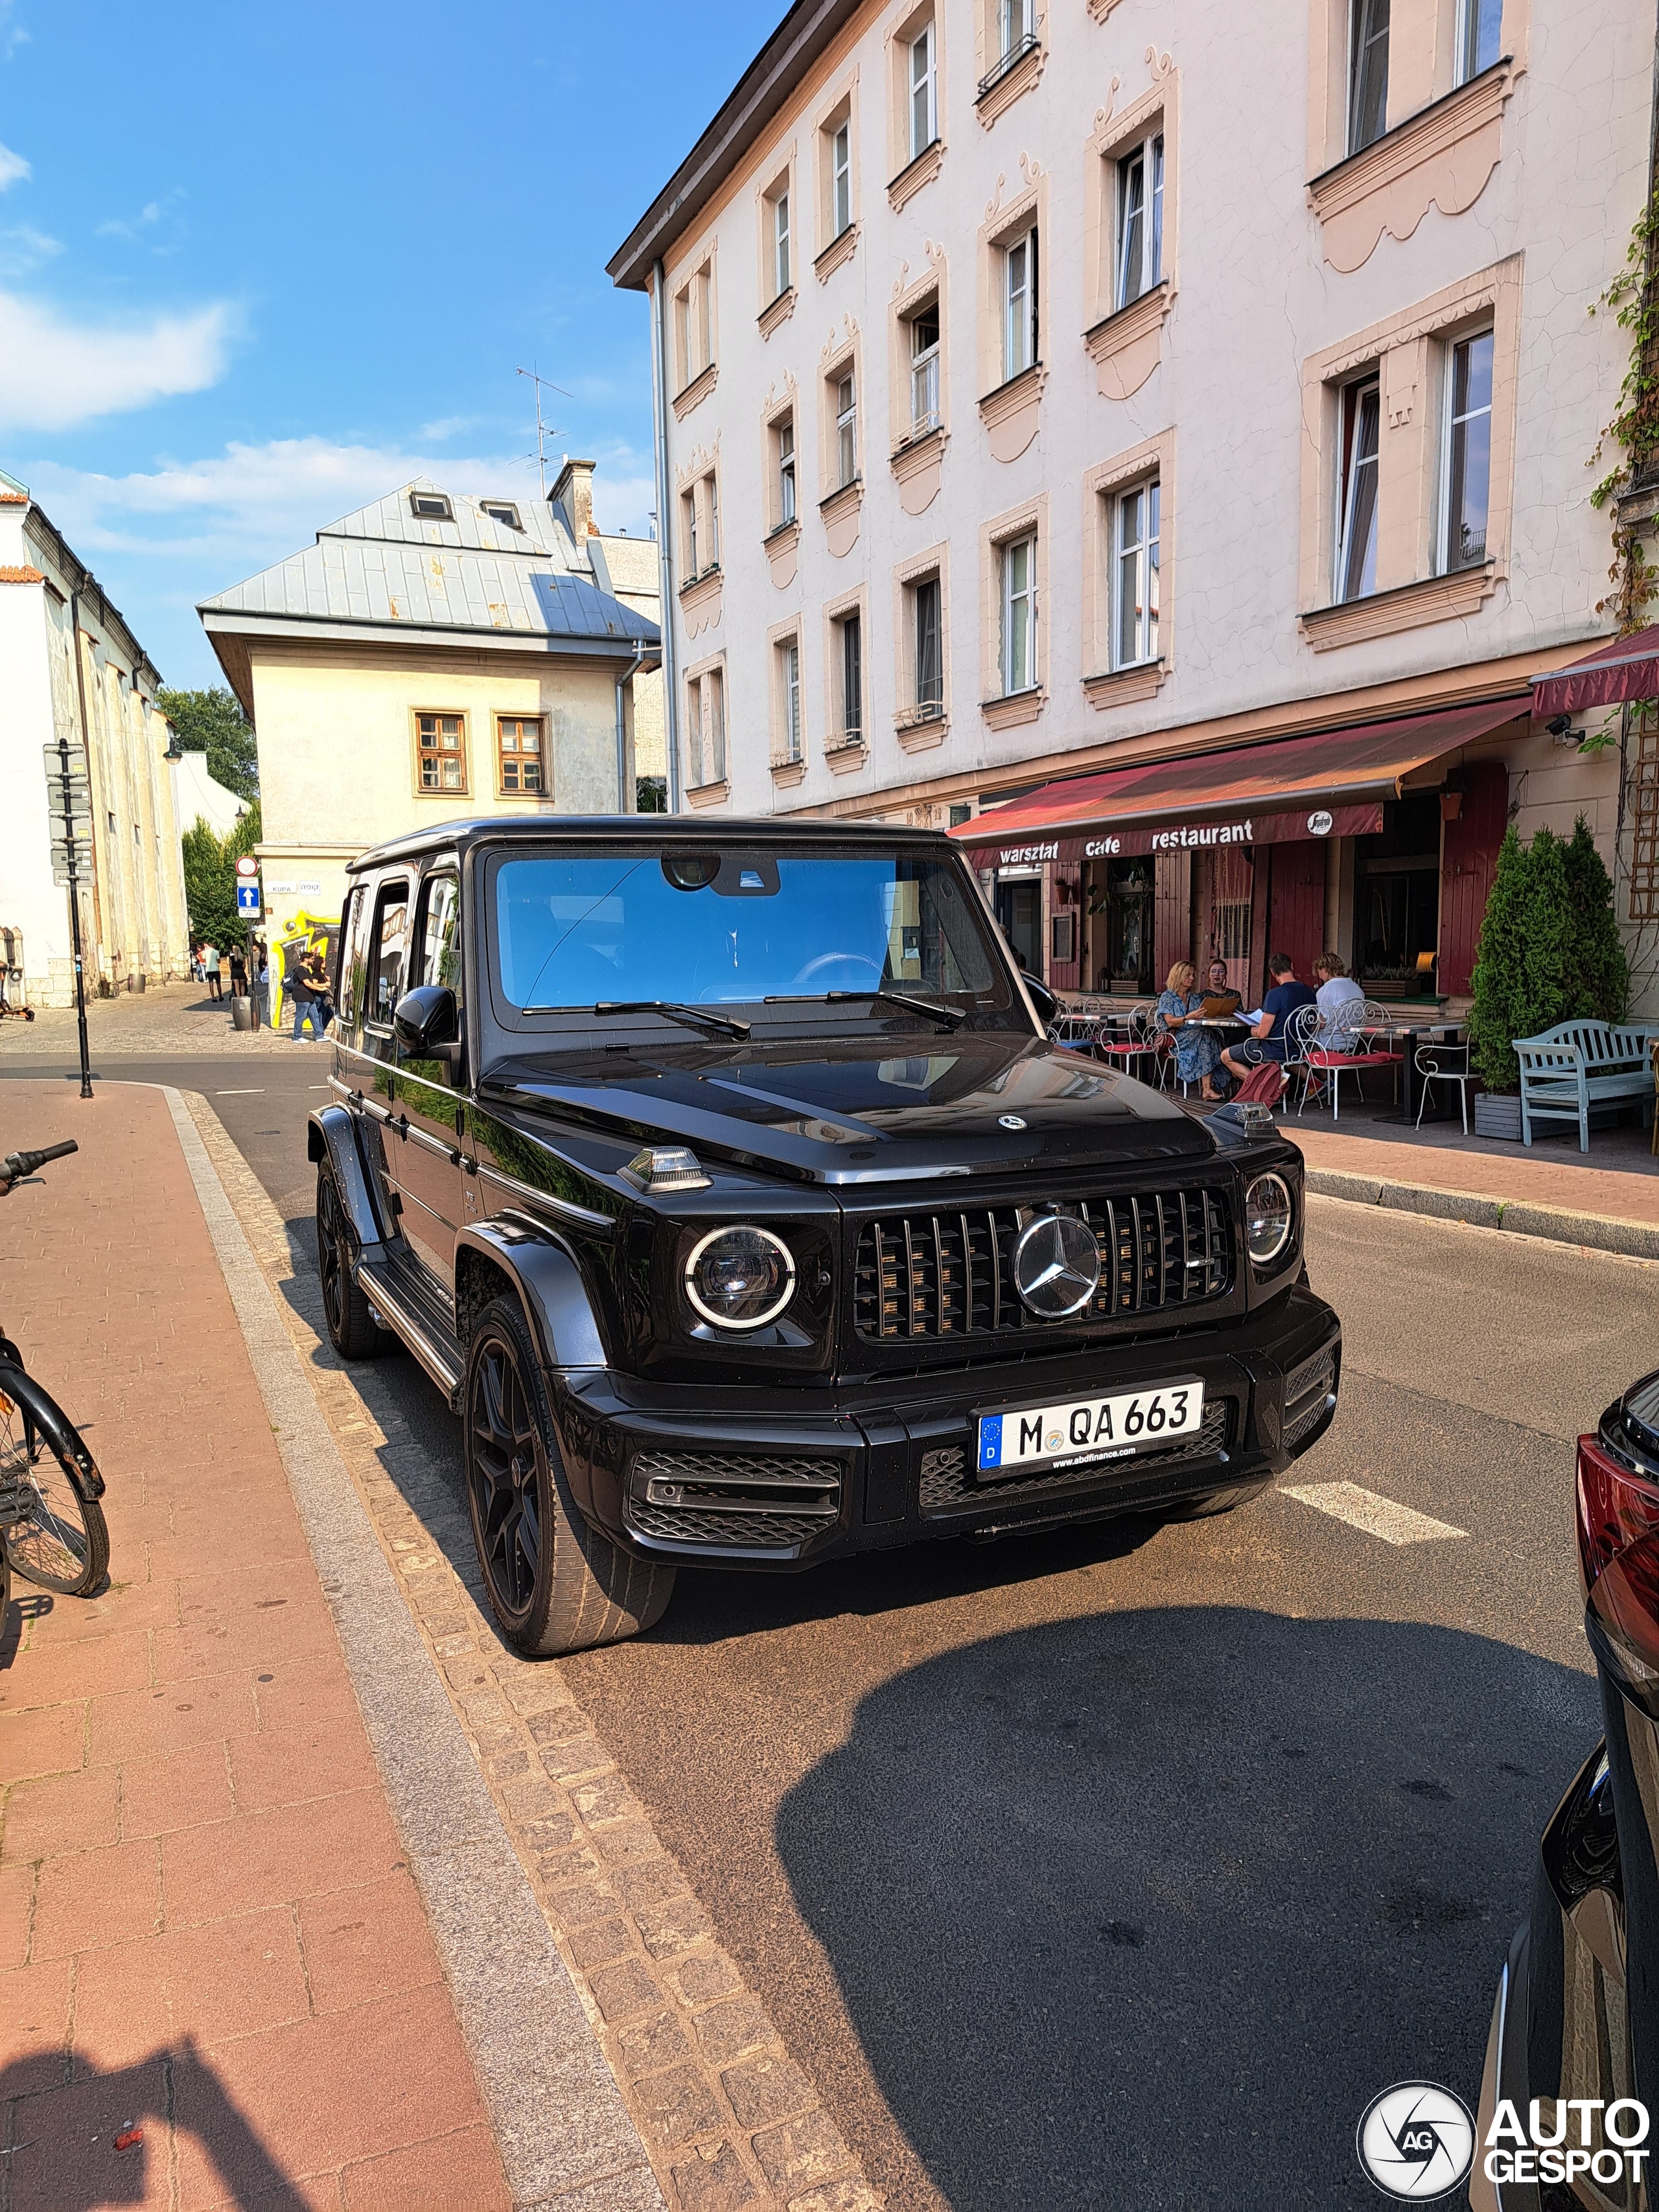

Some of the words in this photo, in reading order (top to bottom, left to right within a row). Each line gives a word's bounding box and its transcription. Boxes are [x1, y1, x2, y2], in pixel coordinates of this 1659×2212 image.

[1000, 841, 1059, 864] warsztat
[1085, 835, 1120, 856] cafe
[1152, 819, 1253, 850] restaurant
[1019, 1415, 1043, 1455] M
[1069, 1404, 1114, 1445] QA
[1124, 1390, 1189, 1436] 663
[986, 1447, 995, 1459] D
[1052, 1447, 1136, 1469] www.abdfinance.com
